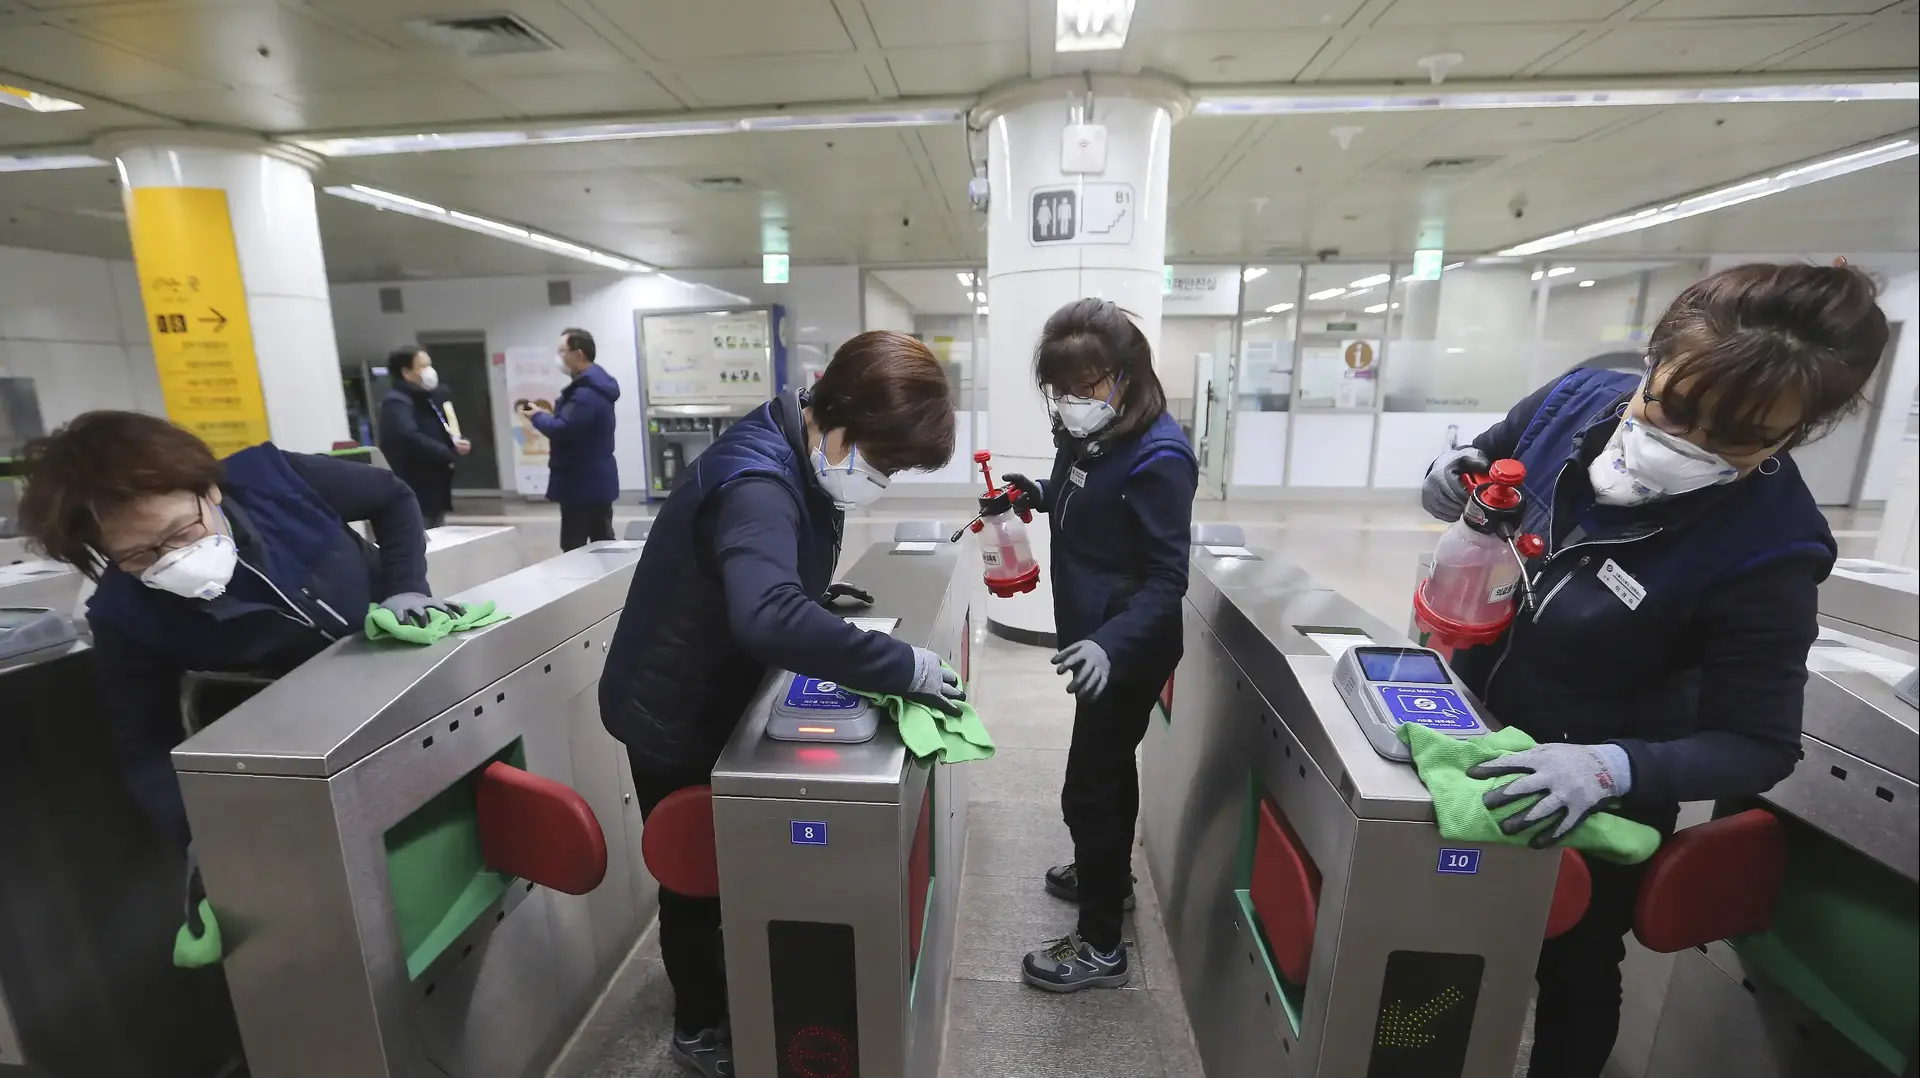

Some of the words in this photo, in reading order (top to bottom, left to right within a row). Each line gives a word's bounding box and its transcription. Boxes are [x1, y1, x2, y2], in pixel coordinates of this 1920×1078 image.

[1115, 191, 1130, 203] B1
[804, 826, 814, 839] 8
[1448, 854, 1469, 868] 10
